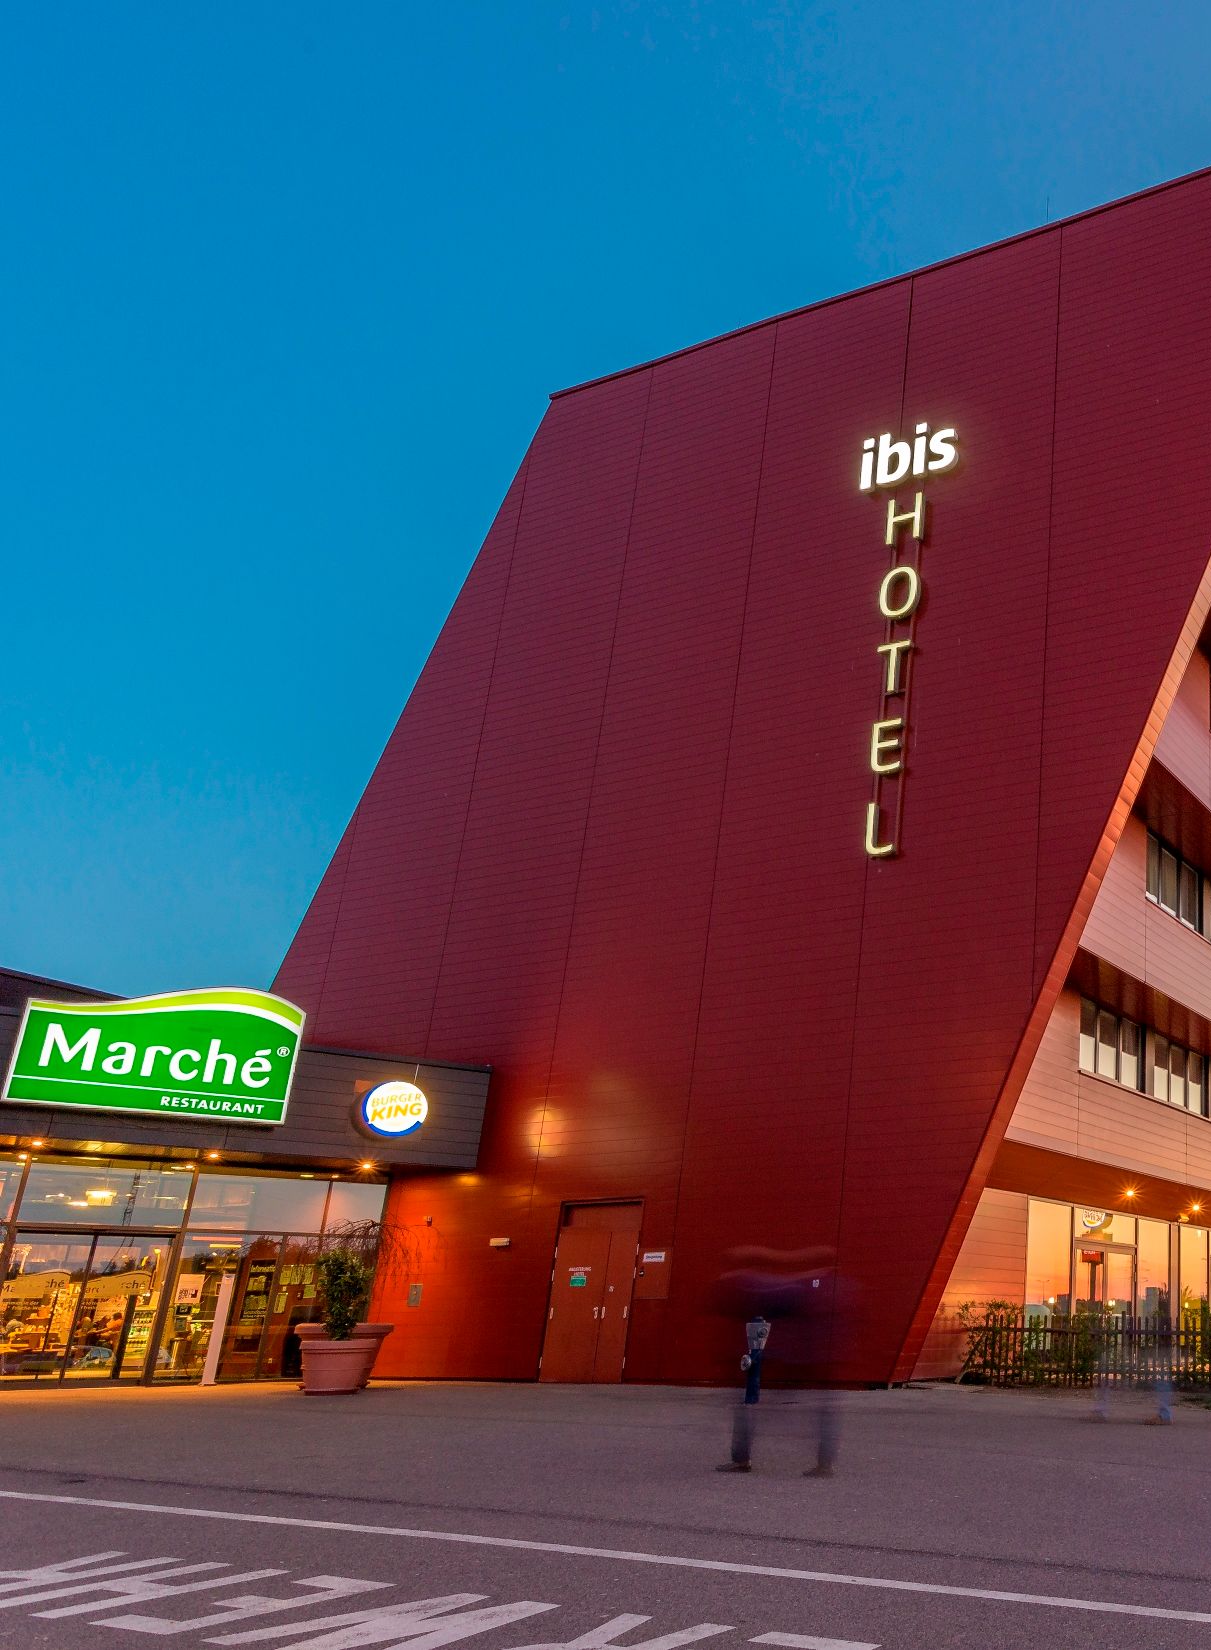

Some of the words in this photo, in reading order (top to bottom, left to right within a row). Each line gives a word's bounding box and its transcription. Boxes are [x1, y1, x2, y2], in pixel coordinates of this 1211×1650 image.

[860, 421, 958, 490] ibis
[864, 491, 924, 858] HOTEL
[160, 1096, 265, 1115] RESTAURANT
[371, 1092, 422, 1107] BURGER
[370, 1102, 423, 1122] KING
